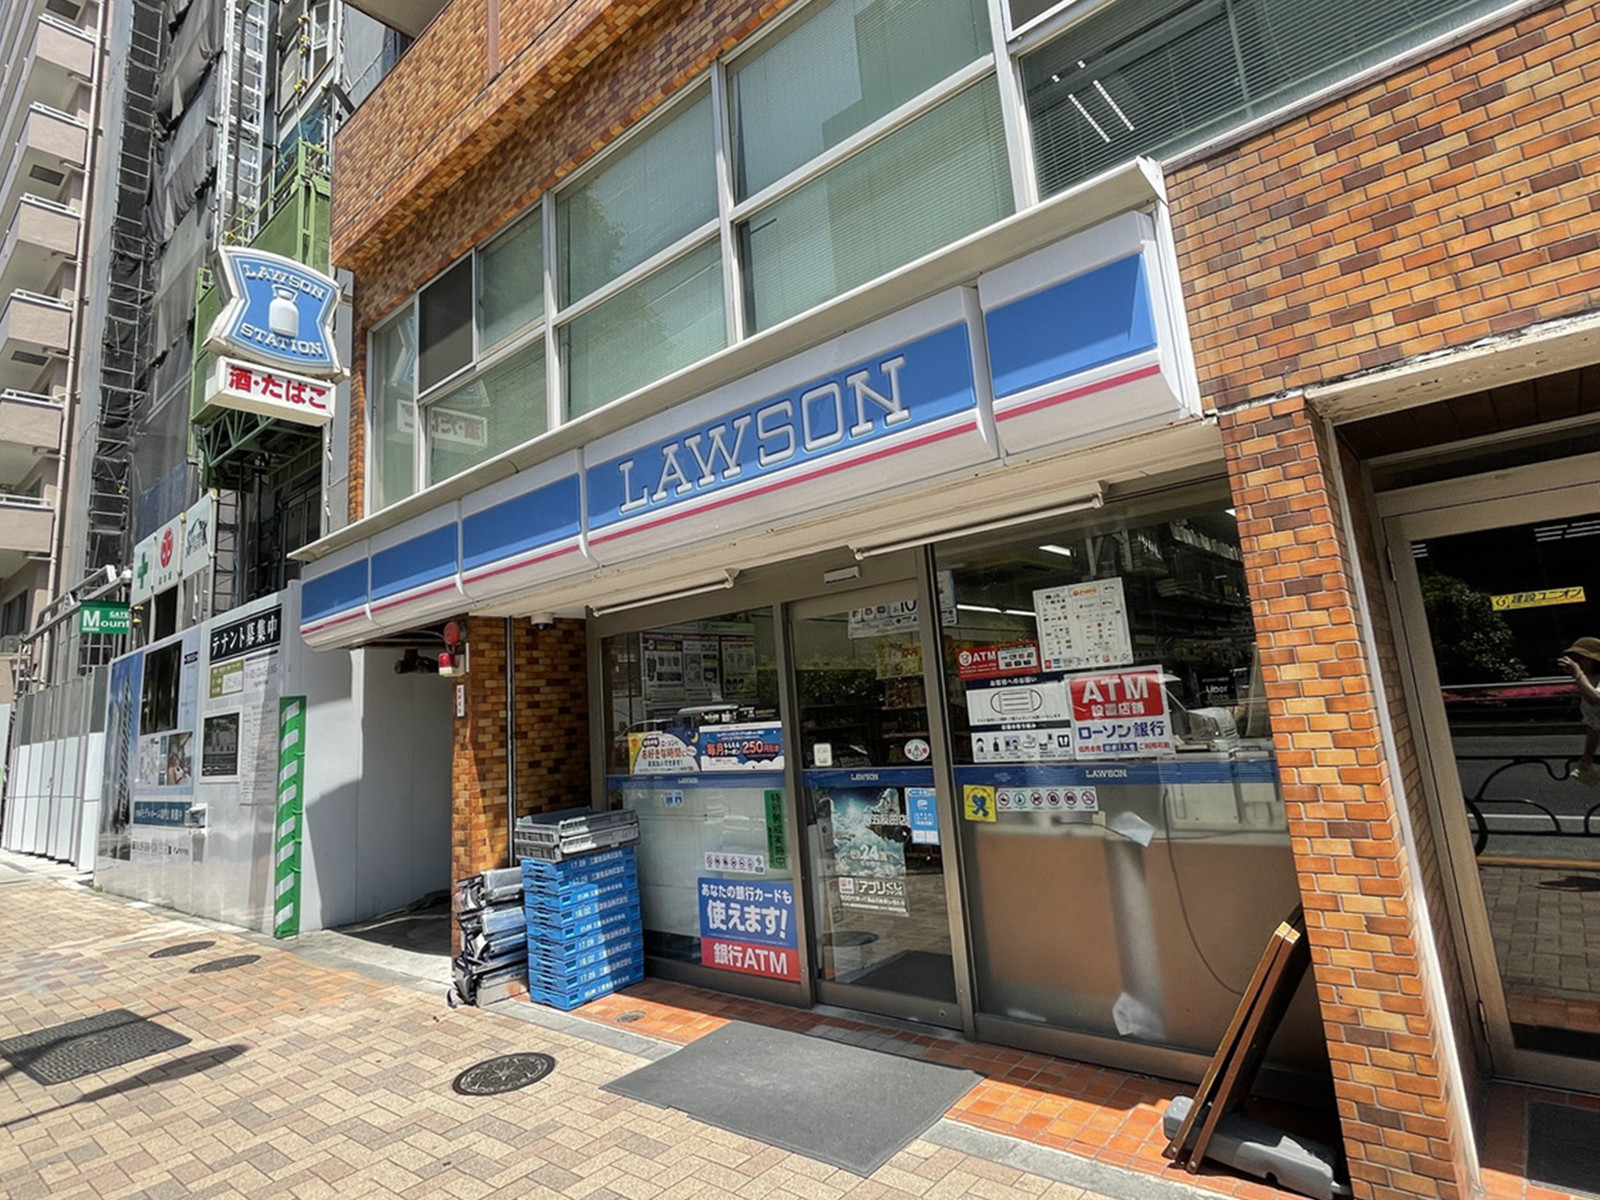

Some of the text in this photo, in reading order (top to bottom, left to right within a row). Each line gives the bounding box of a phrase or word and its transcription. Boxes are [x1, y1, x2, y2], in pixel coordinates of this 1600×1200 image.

[242, 263, 325, 300] LAWSON
[240, 322, 324, 356] STATION
[229, 365, 327, 409] 酒・たばこ
[618, 355, 911, 515] LAWSON
[212, 615, 278, 656] テナント募集中
[973, 650, 997, 663] ATM
[1082, 675, 1149, 704] ATM
[1091, 701, 1145, 717] 設置店舗
[1078, 720, 1165, 740] ローソン銀行
[1085, 768, 1128, 778] LAWSON
[860, 844, 878, 860] 24
[701, 884, 793, 905] あなたの銀行カードも
[707, 899, 788, 940] 使えます!
[713, 942, 788, 975] 銀行ATM
